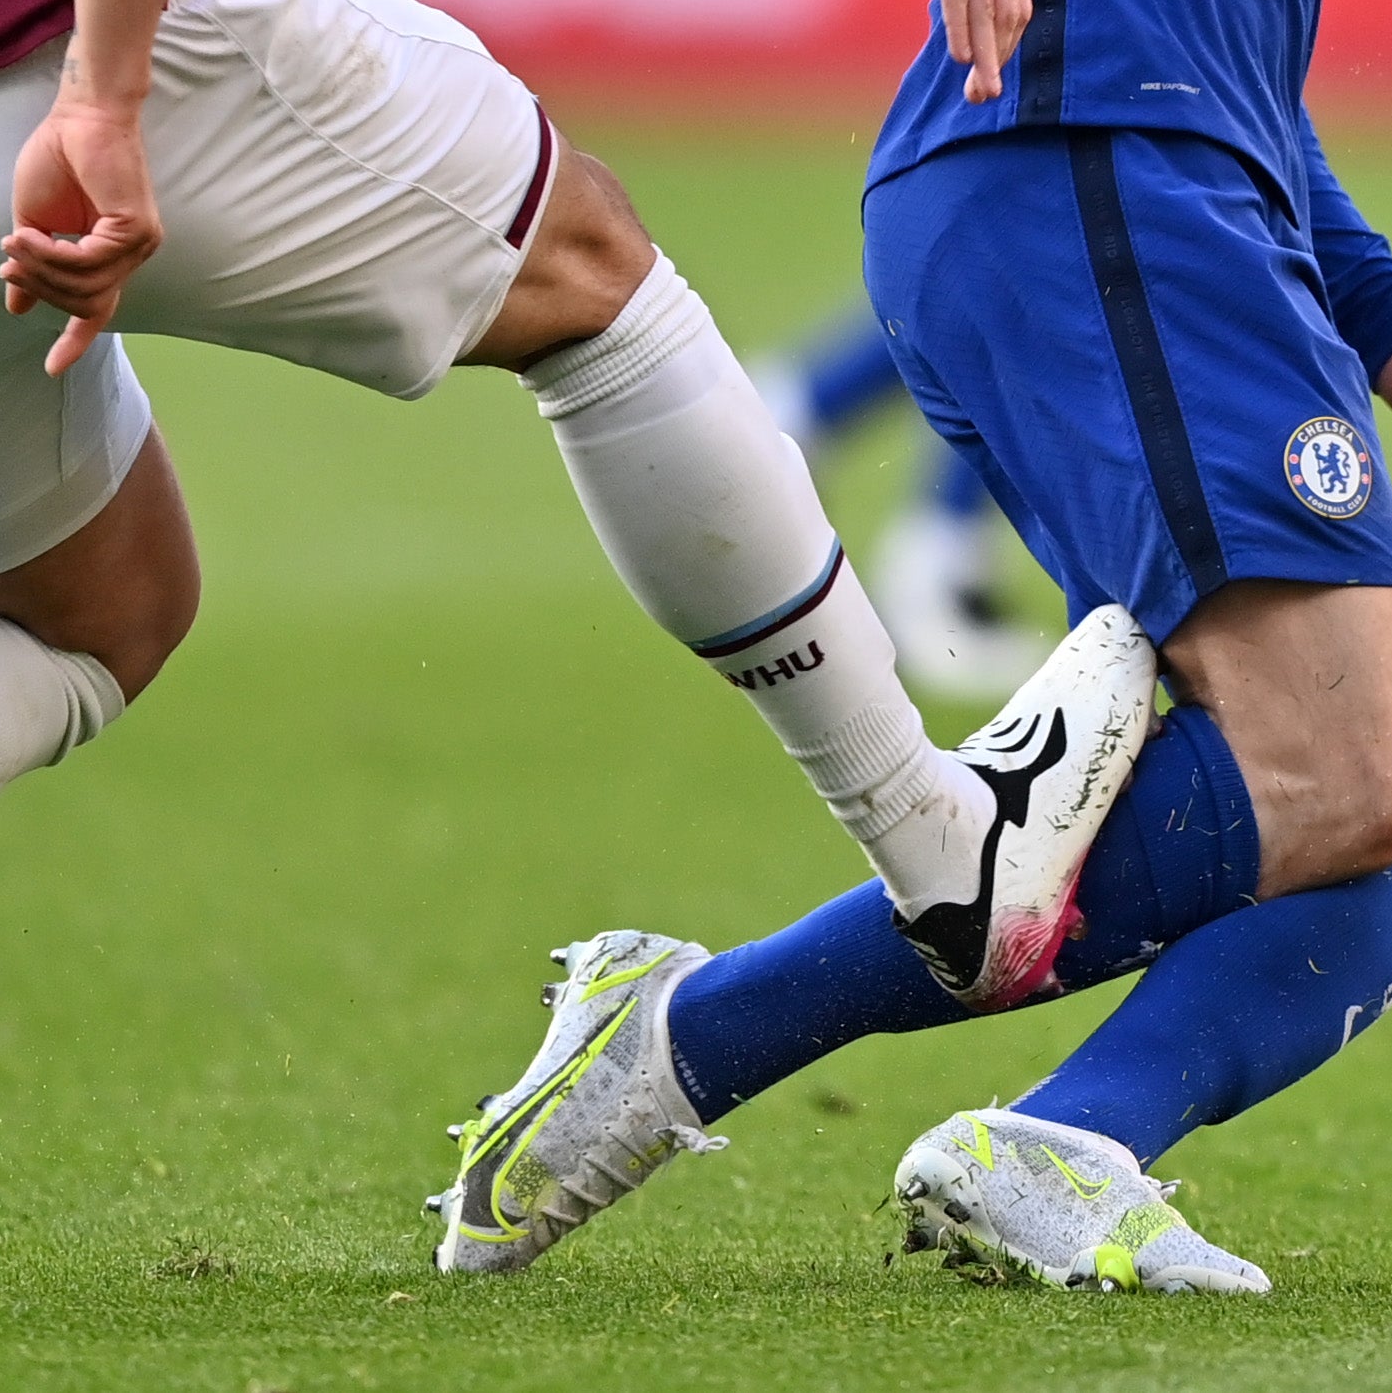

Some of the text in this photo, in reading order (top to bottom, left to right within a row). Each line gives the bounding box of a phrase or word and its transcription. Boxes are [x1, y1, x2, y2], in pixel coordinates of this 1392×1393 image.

[1296, 420, 1355, 444] CHELSEA
[1306, 494, 1364, 514] FOOTBALL CLUB
